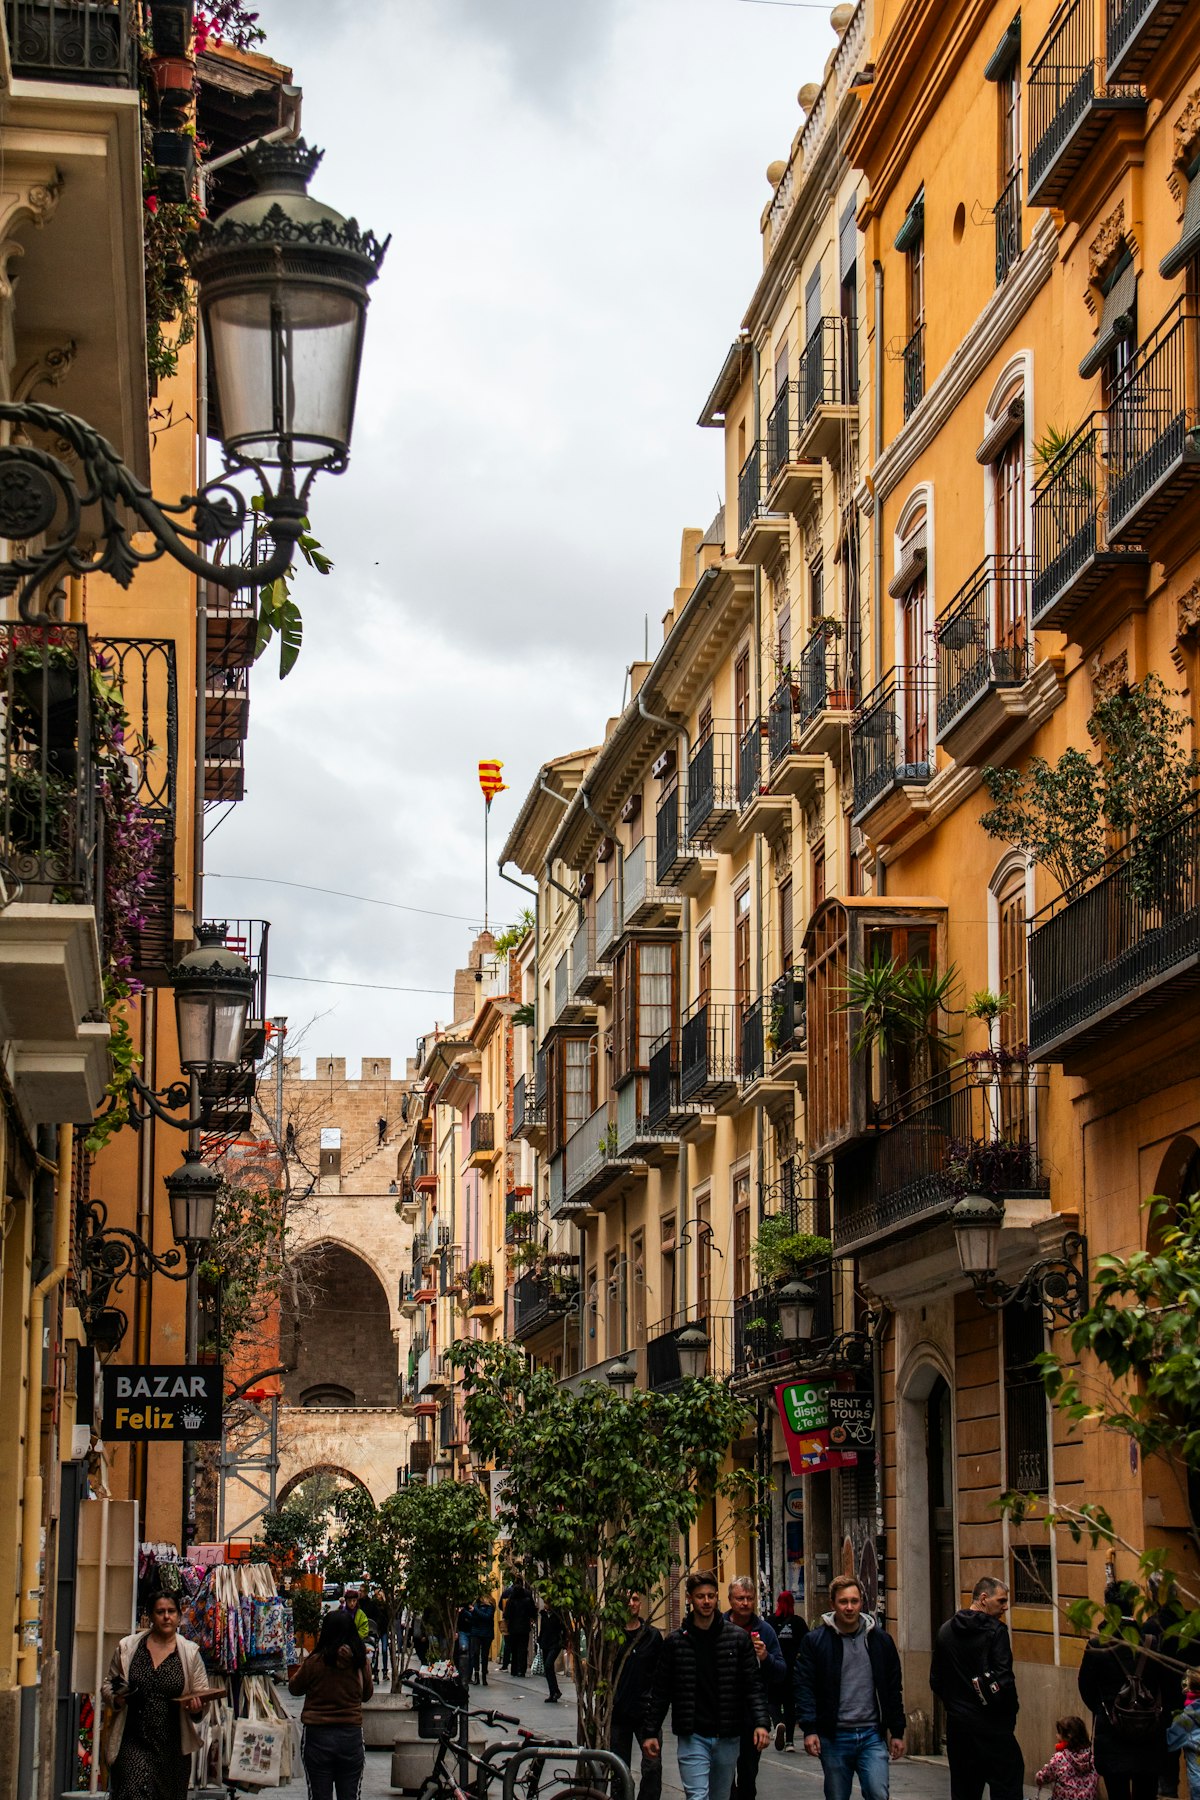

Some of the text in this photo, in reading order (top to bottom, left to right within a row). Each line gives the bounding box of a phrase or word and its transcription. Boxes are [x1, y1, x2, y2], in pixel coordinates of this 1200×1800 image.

[116, 1376, 208, 1398] BAZAR
[830, 1398, 873, 1409] RENT &
[115, 1405, 174, 1430] Feliz
[832, 1409, 871, 1419] TOURS
[796, 1417, 813, 1431] ¿Te
